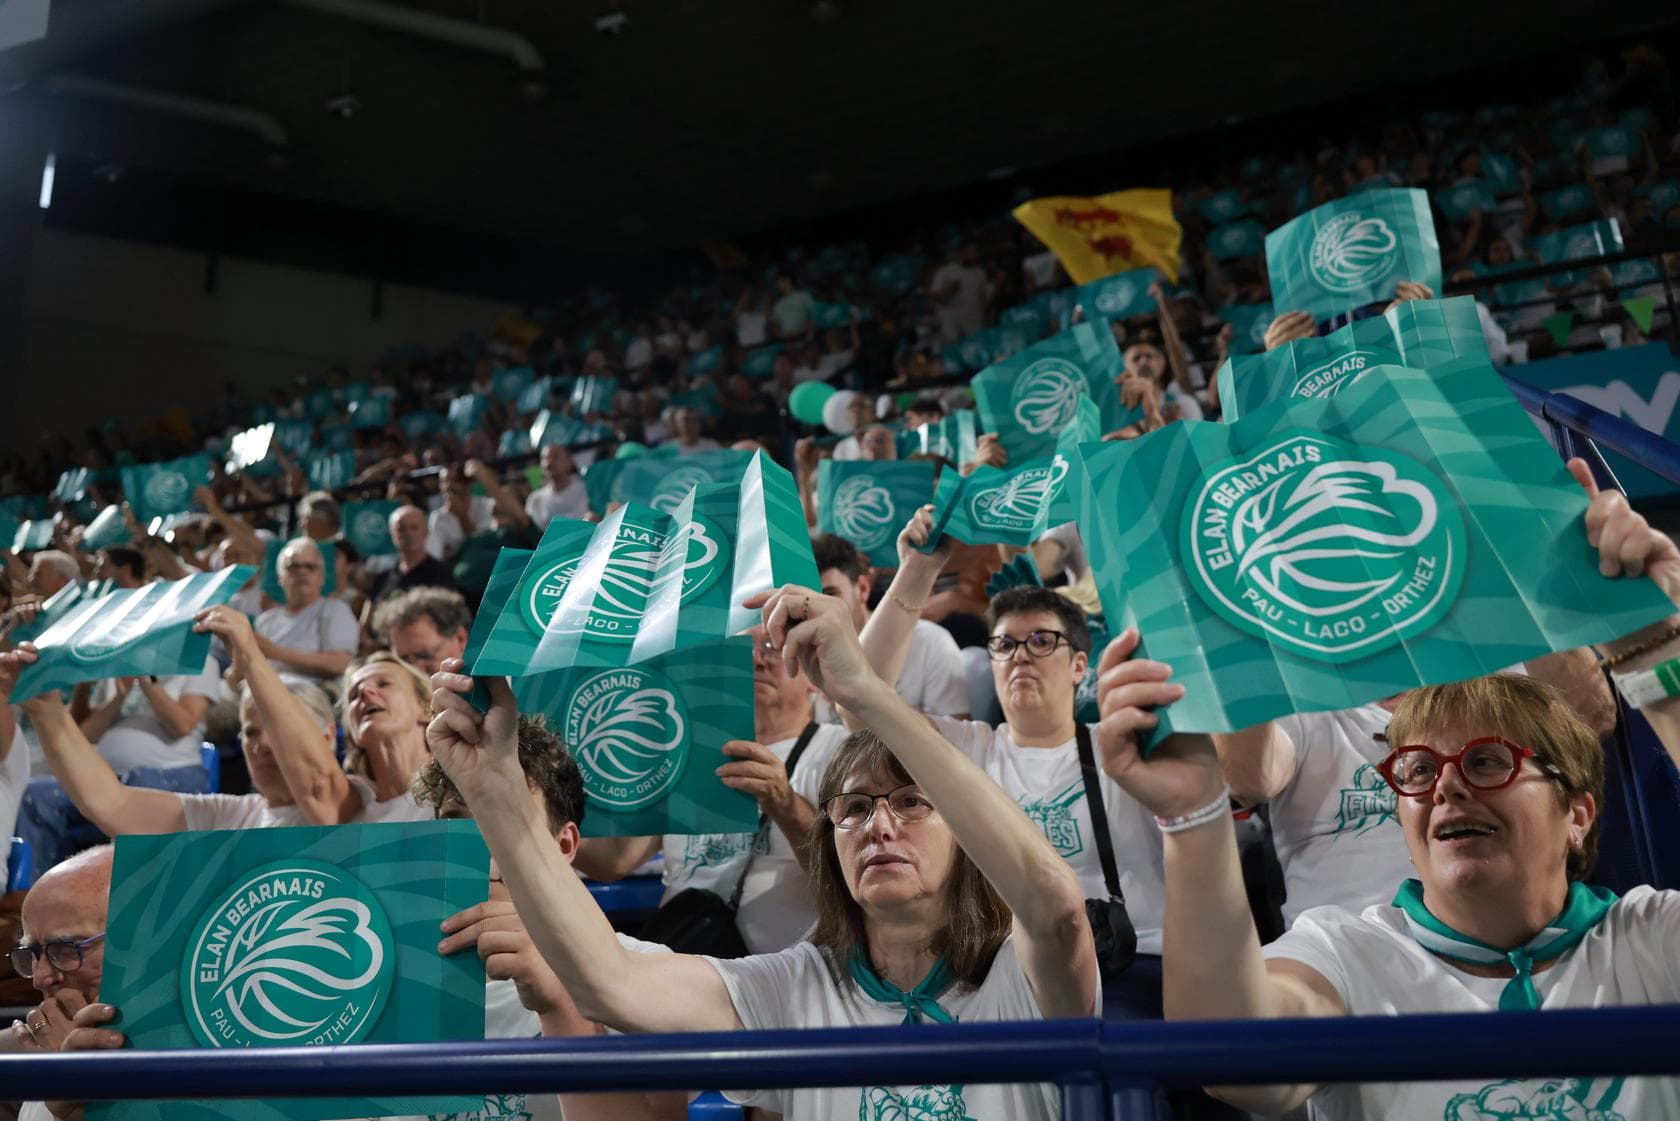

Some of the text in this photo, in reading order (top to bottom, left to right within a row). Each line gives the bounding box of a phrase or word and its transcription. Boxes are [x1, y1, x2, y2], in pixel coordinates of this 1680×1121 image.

[1299, 356, 1366, 398] BEARNAIS
[1203, 445, 1321, 571] ELAN BEARNAIS
[542, 567, 577, 597] ELAN
[1241, 587, 1283, 621] PAU
[1382, 556, 1437, 615] ORTHEZ
[569, 674, 642, 746] ELAN BEARNAIS
[576, 762, 593, 784] PAU
[636, 758, 674, 795] ORTHEZ
[200, 877, 325, 983] ELAN BEARNAIS
[210, 1008, 236, 1039] PAU
